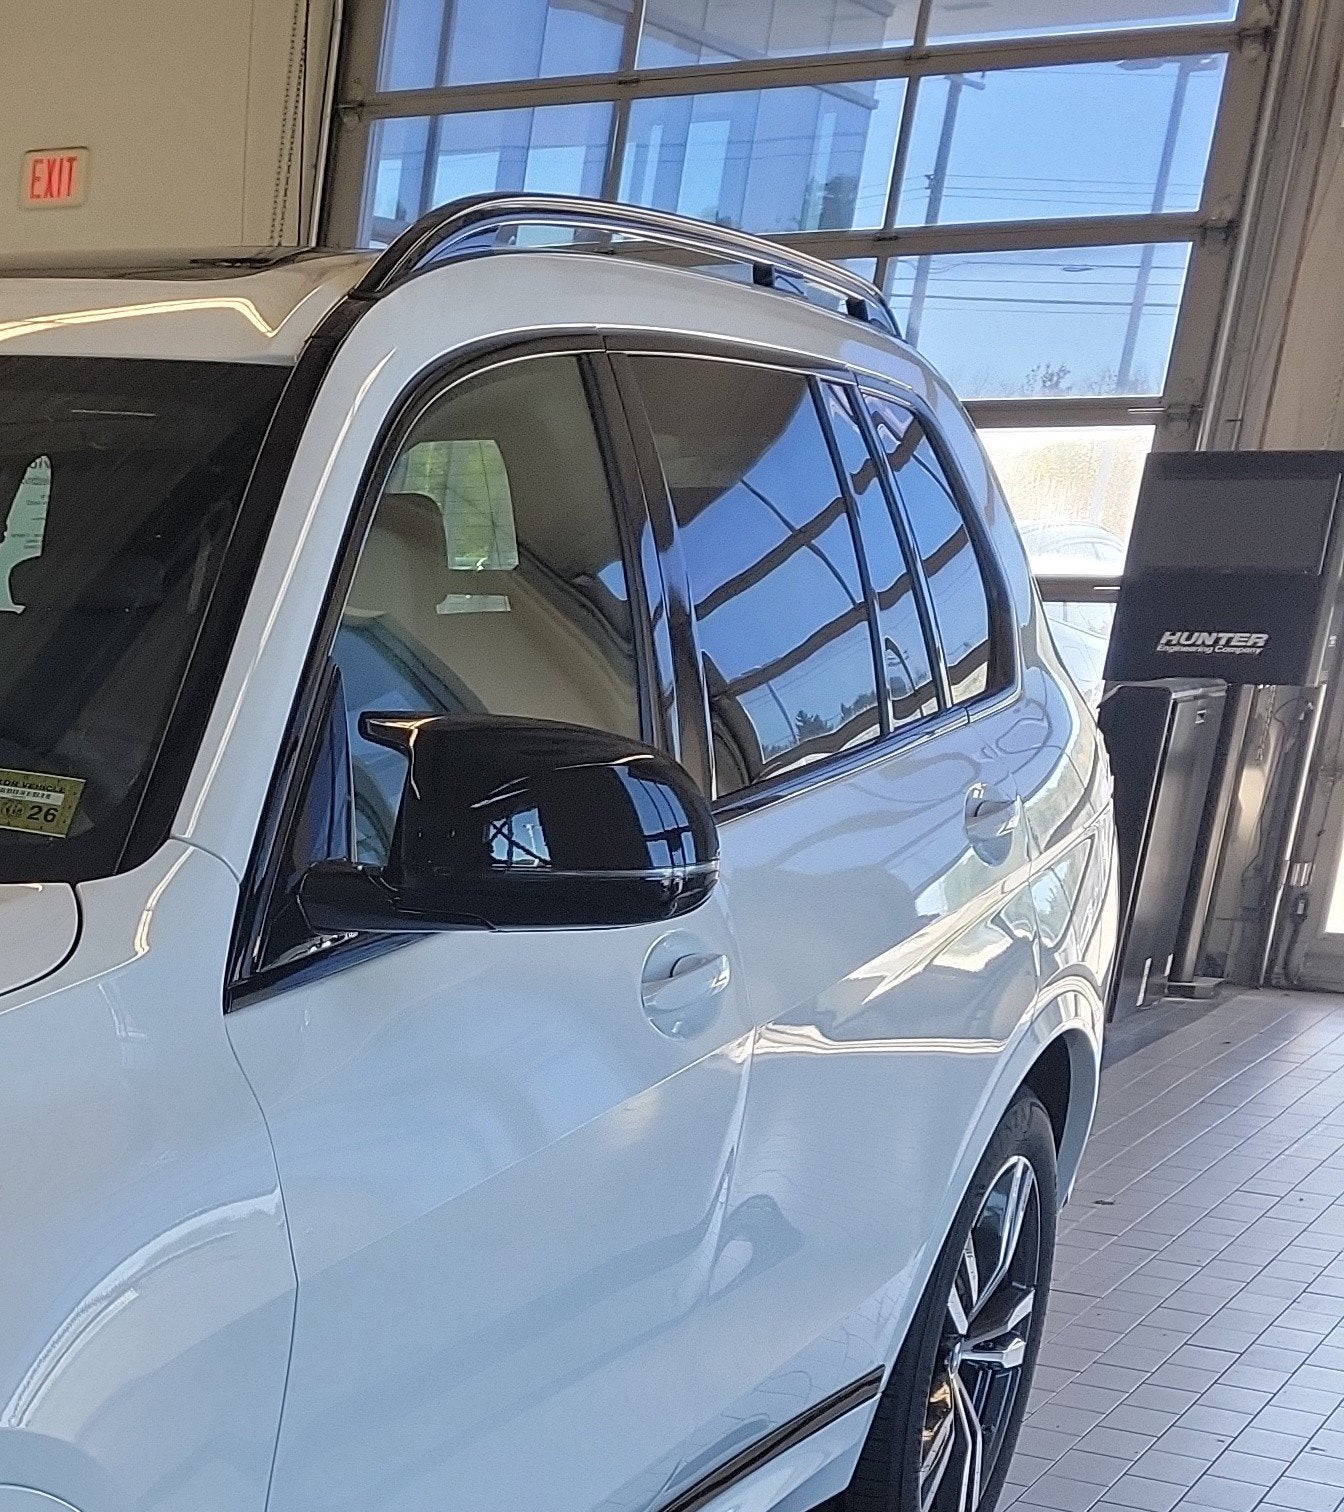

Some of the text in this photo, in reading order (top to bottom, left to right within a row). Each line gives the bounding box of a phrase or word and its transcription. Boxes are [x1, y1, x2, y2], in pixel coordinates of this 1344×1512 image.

[30, 156, 78, 198] EXIT
[1159, 631, 1269, 647] HUNTER
[1156, 644, 1264, 655] Engineering Company
[22, 781, 66, 794] VEHICLE
[26, 804, 59, 823] 26
